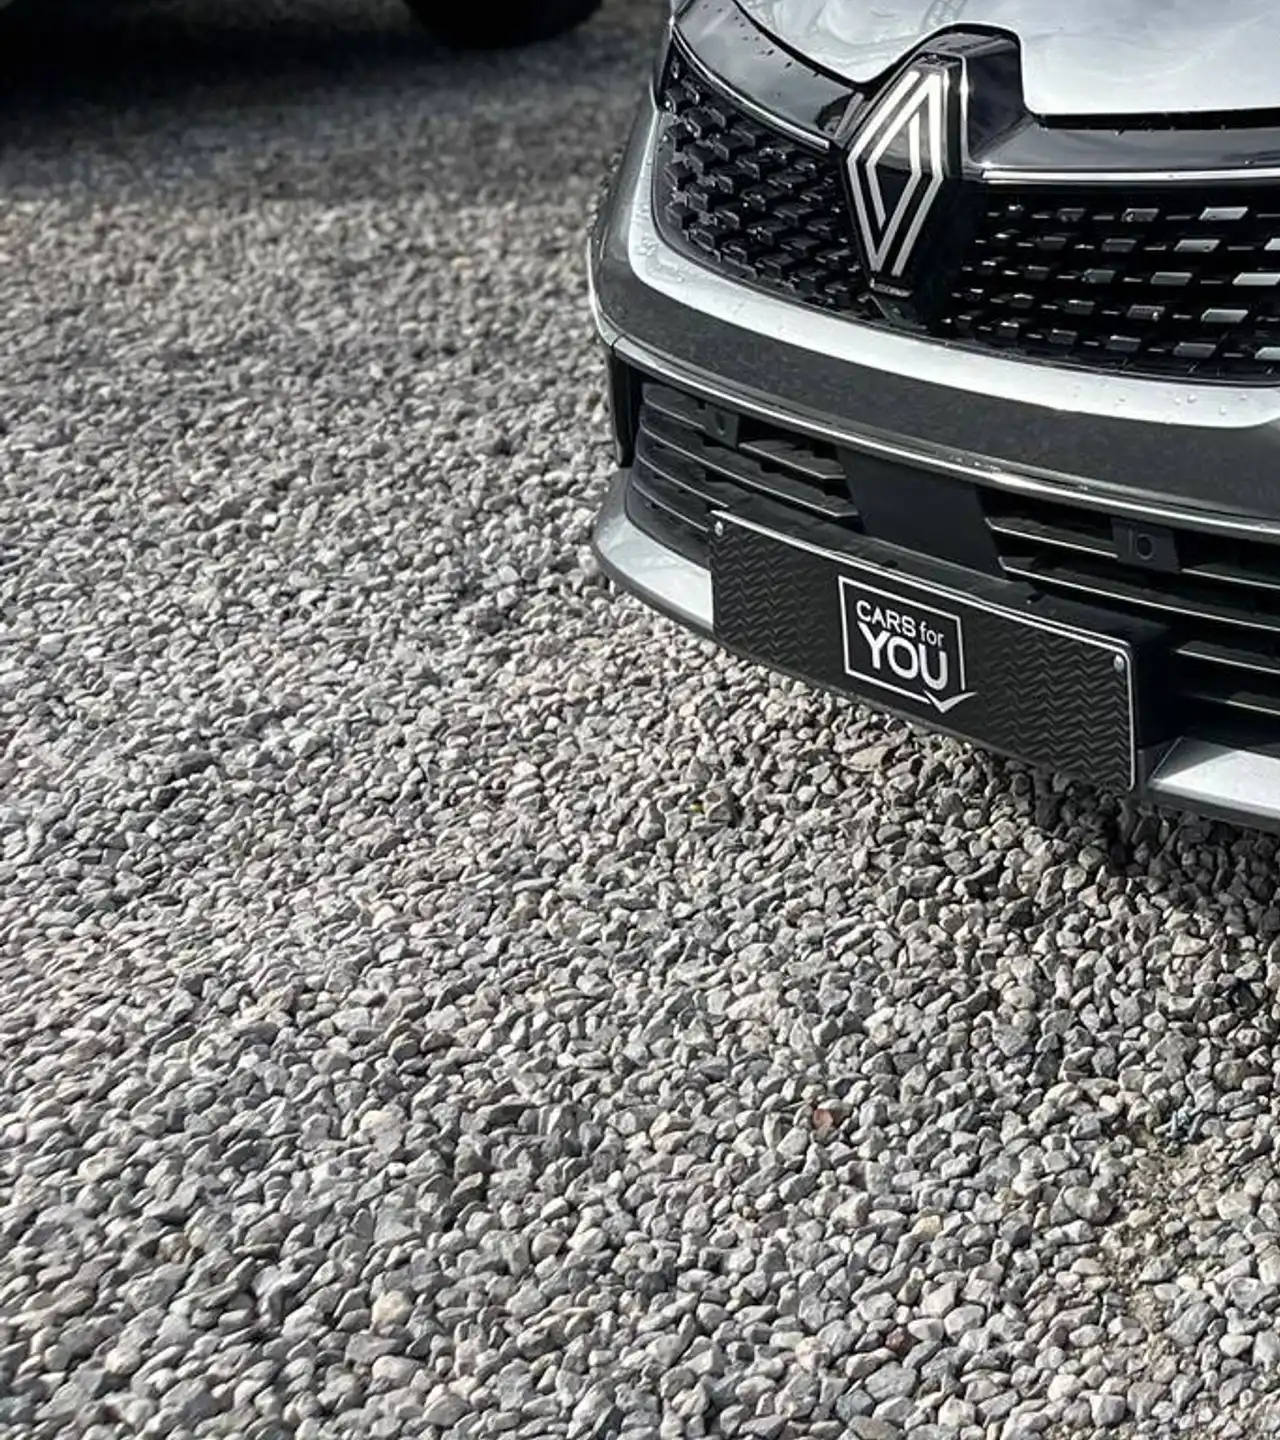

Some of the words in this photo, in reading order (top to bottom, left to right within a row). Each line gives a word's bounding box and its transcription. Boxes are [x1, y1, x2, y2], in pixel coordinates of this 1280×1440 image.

[856, 600, 917, 638] CARS
[919, 621, 945, 647] for
[857, 620, 949, 691] YOU
